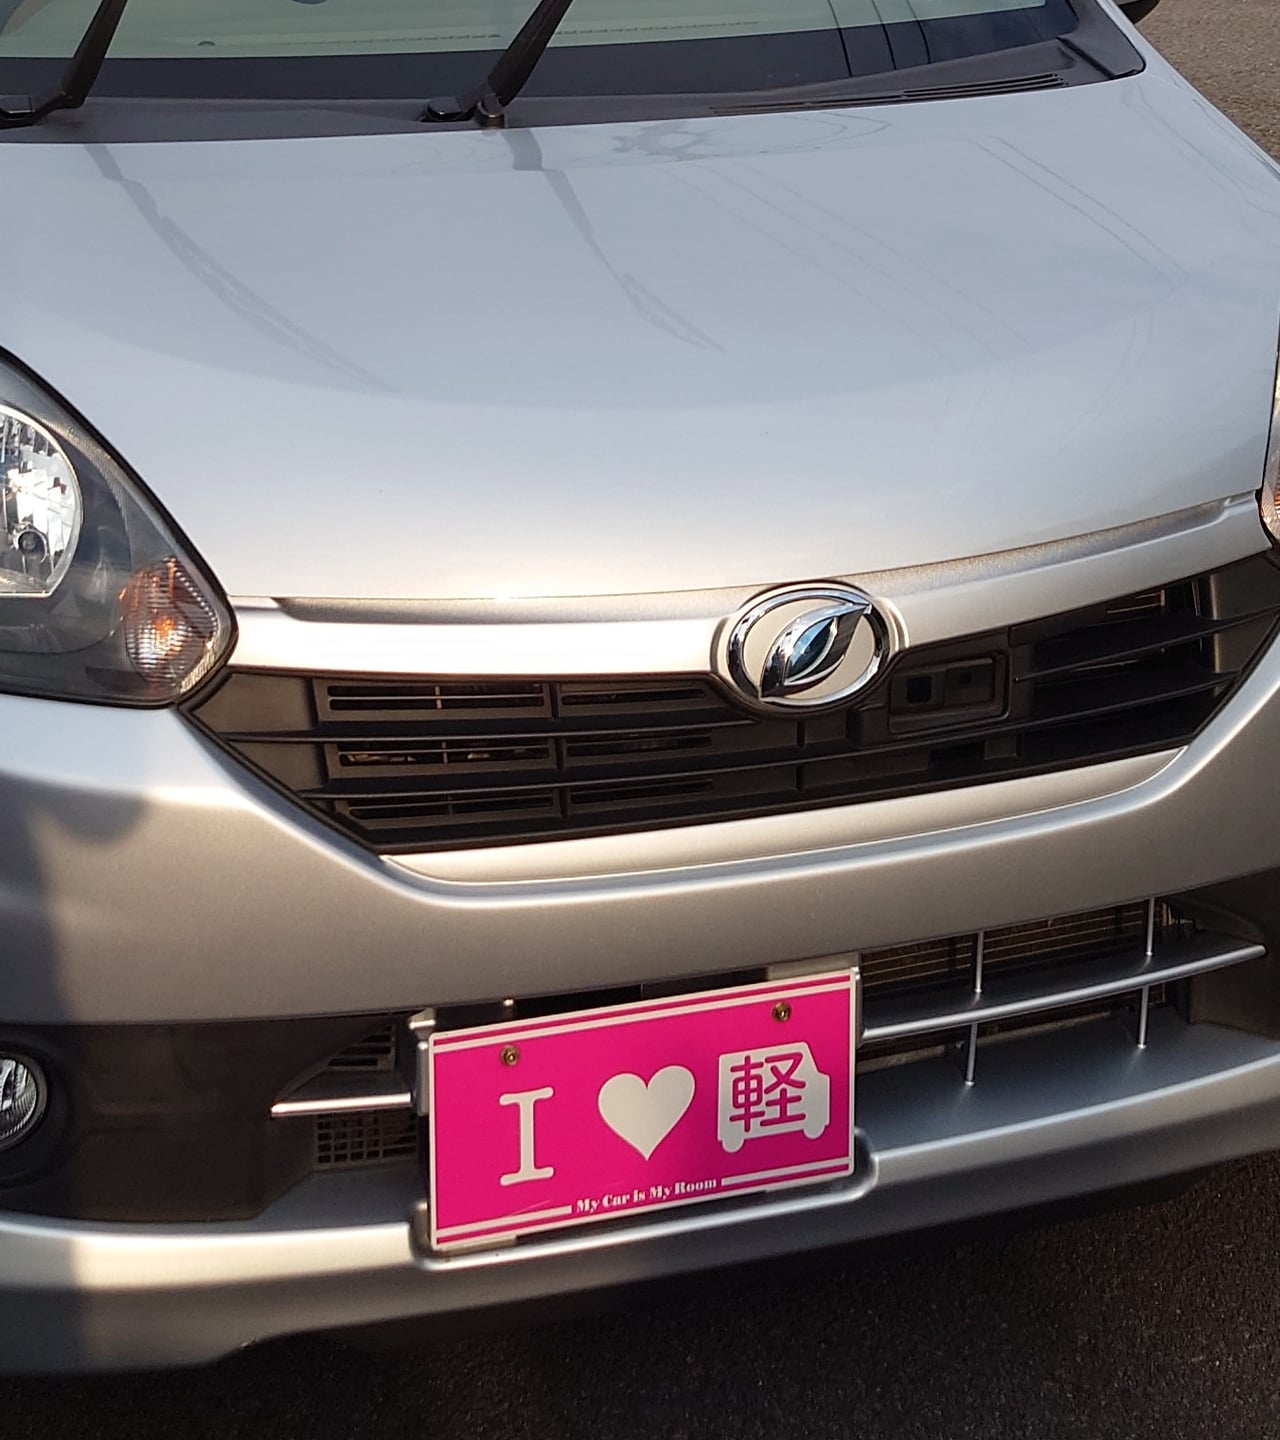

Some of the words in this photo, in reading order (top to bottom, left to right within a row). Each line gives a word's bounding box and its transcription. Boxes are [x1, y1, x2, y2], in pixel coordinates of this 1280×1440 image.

[499, 1087, 554, 1186] I
[729, 1051, 806, 1132] 軽
[576, 1198, 600, 1213] My
[602, 1193, 630, 1207] Car
[633, 1189, 646, 1202] is
[649, 1185, 673, 1200] My
[674, 1178, 717, 1195] Room
